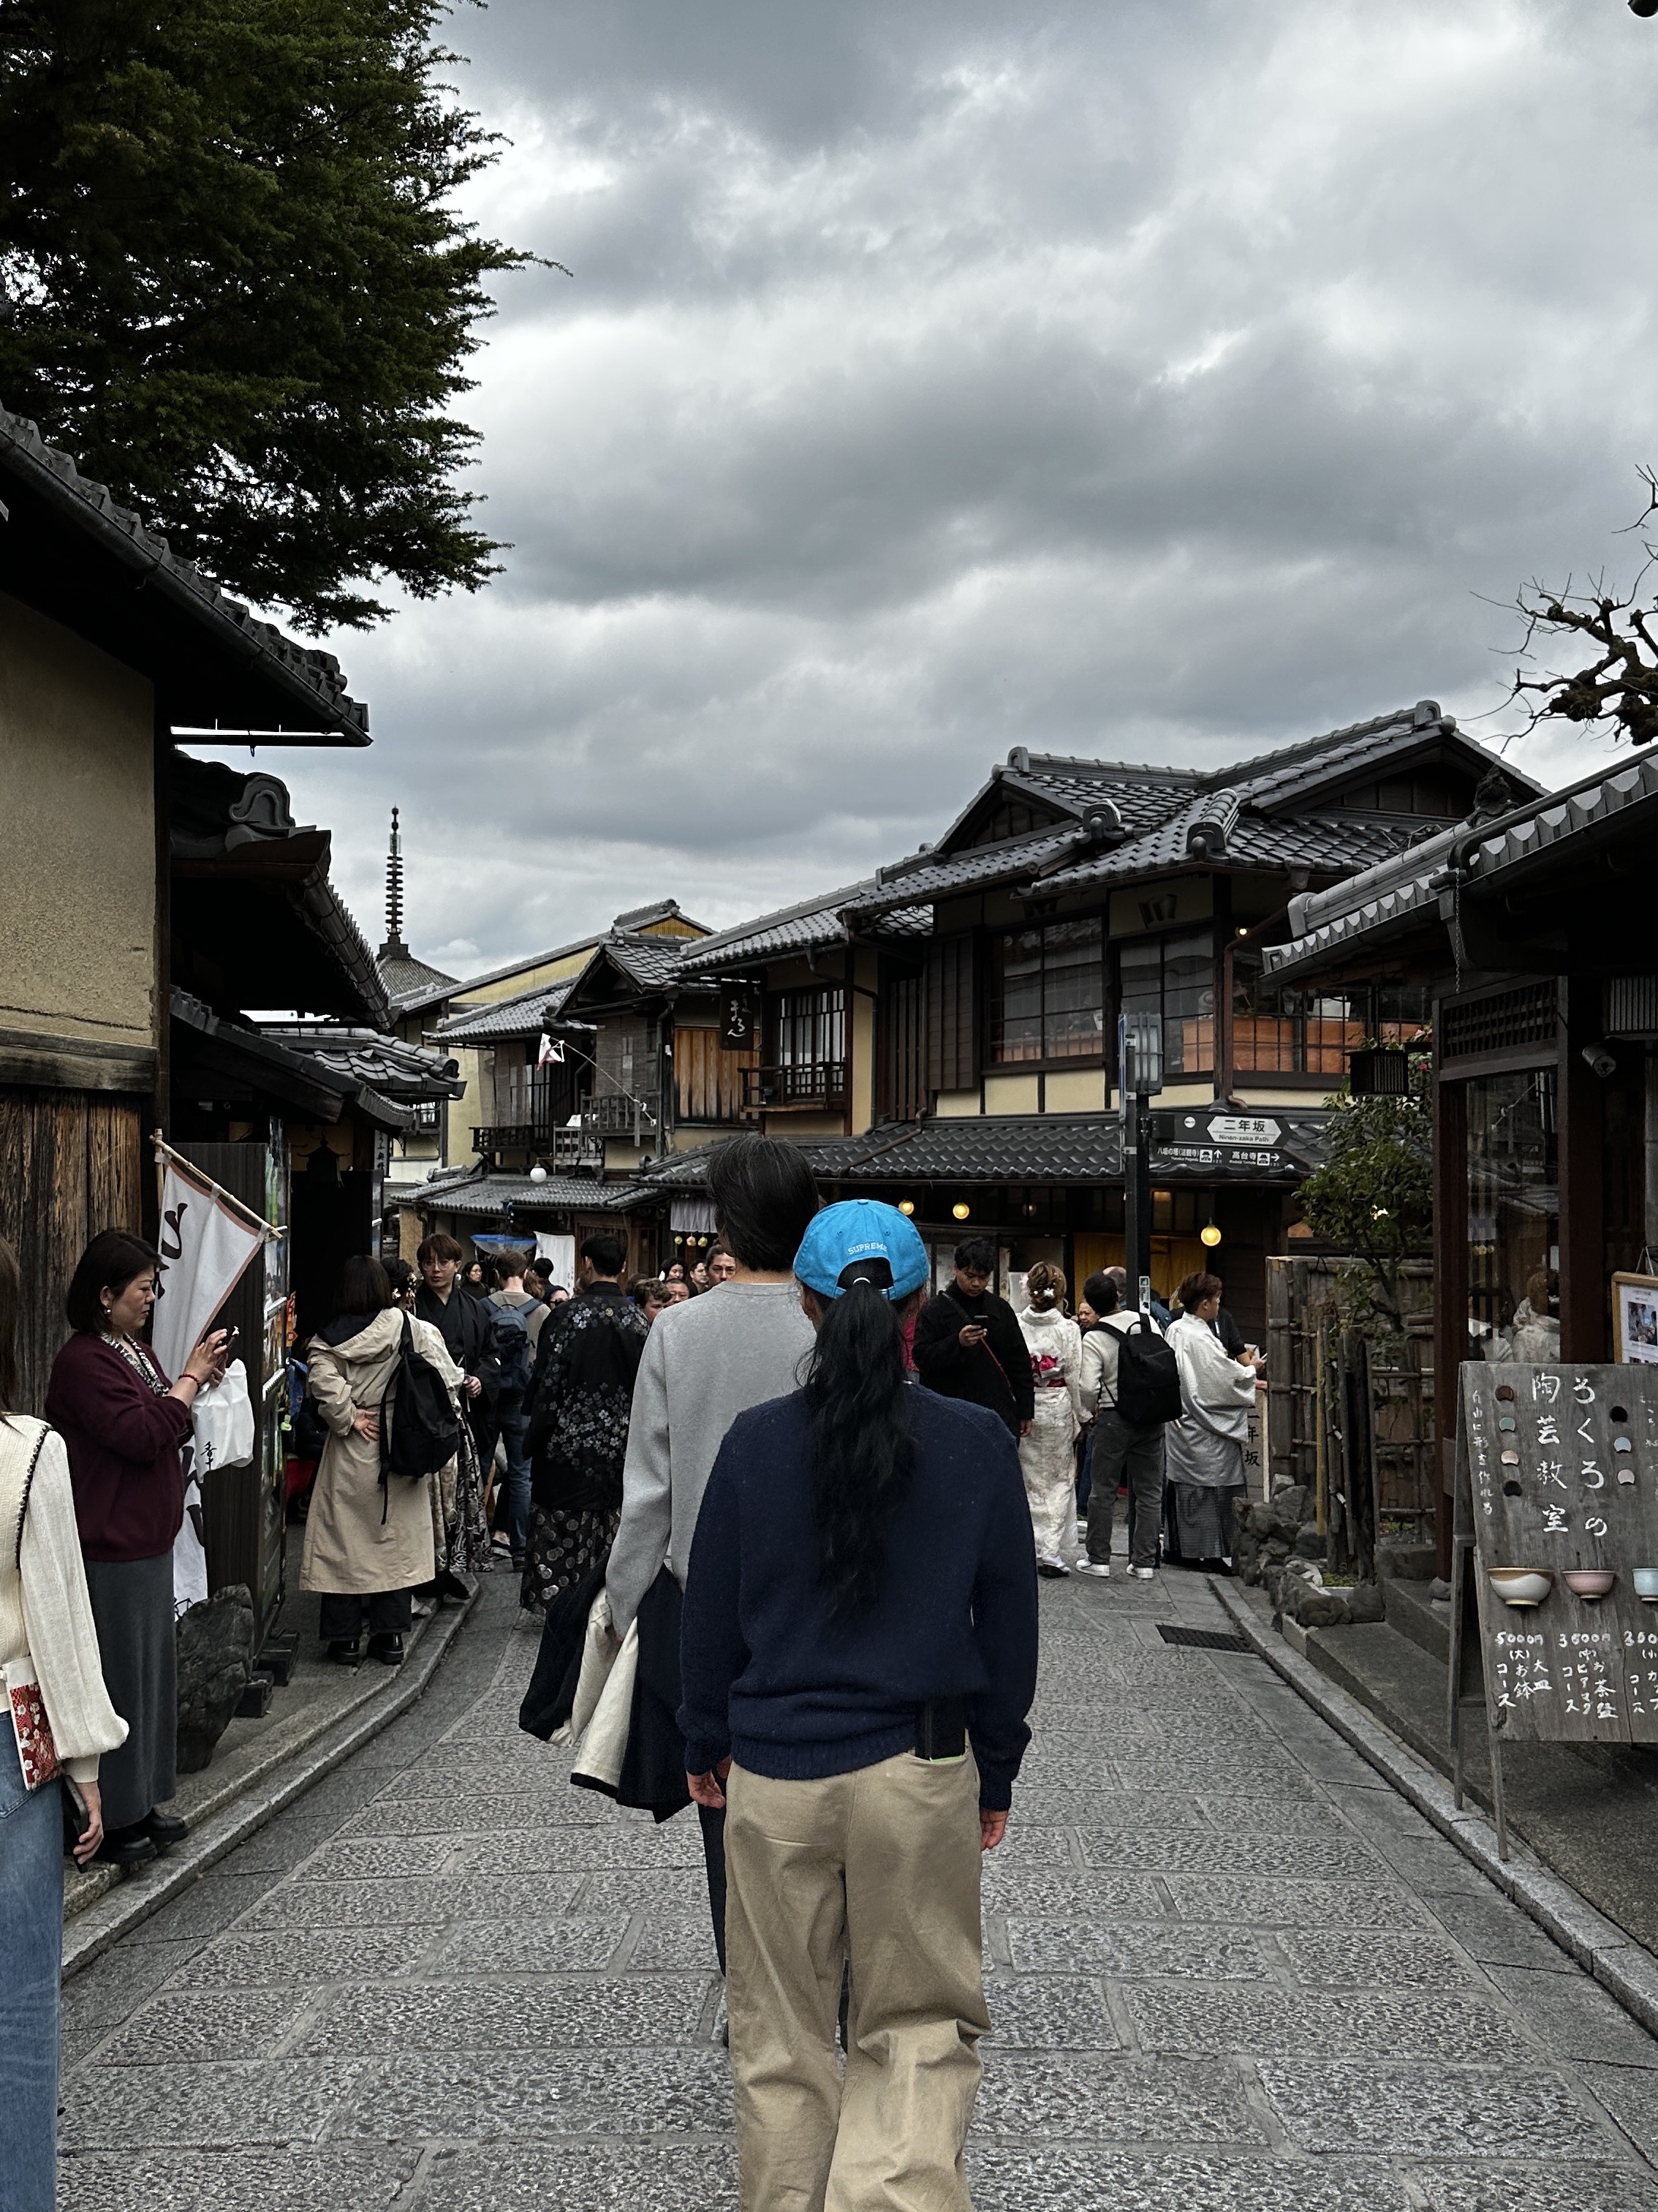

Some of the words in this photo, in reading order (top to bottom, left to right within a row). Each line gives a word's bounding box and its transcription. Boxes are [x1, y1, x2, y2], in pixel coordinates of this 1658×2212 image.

[1224, 1120, 1265, 1133] 二年坂
[1532, 1373, 1569, 1533] 陶芸教室
[1572, 1377, 1608, 1536] ろくろの
[1495, 1631, 1543, 1645] 5000円
[1510, 1649, 1530, 1661] (大)
[1496, 1663, 1516, 1707] コース
[1534, 1659, 1553, 1691] 大皿
[1562, 1666, 1580, 1713] コース
